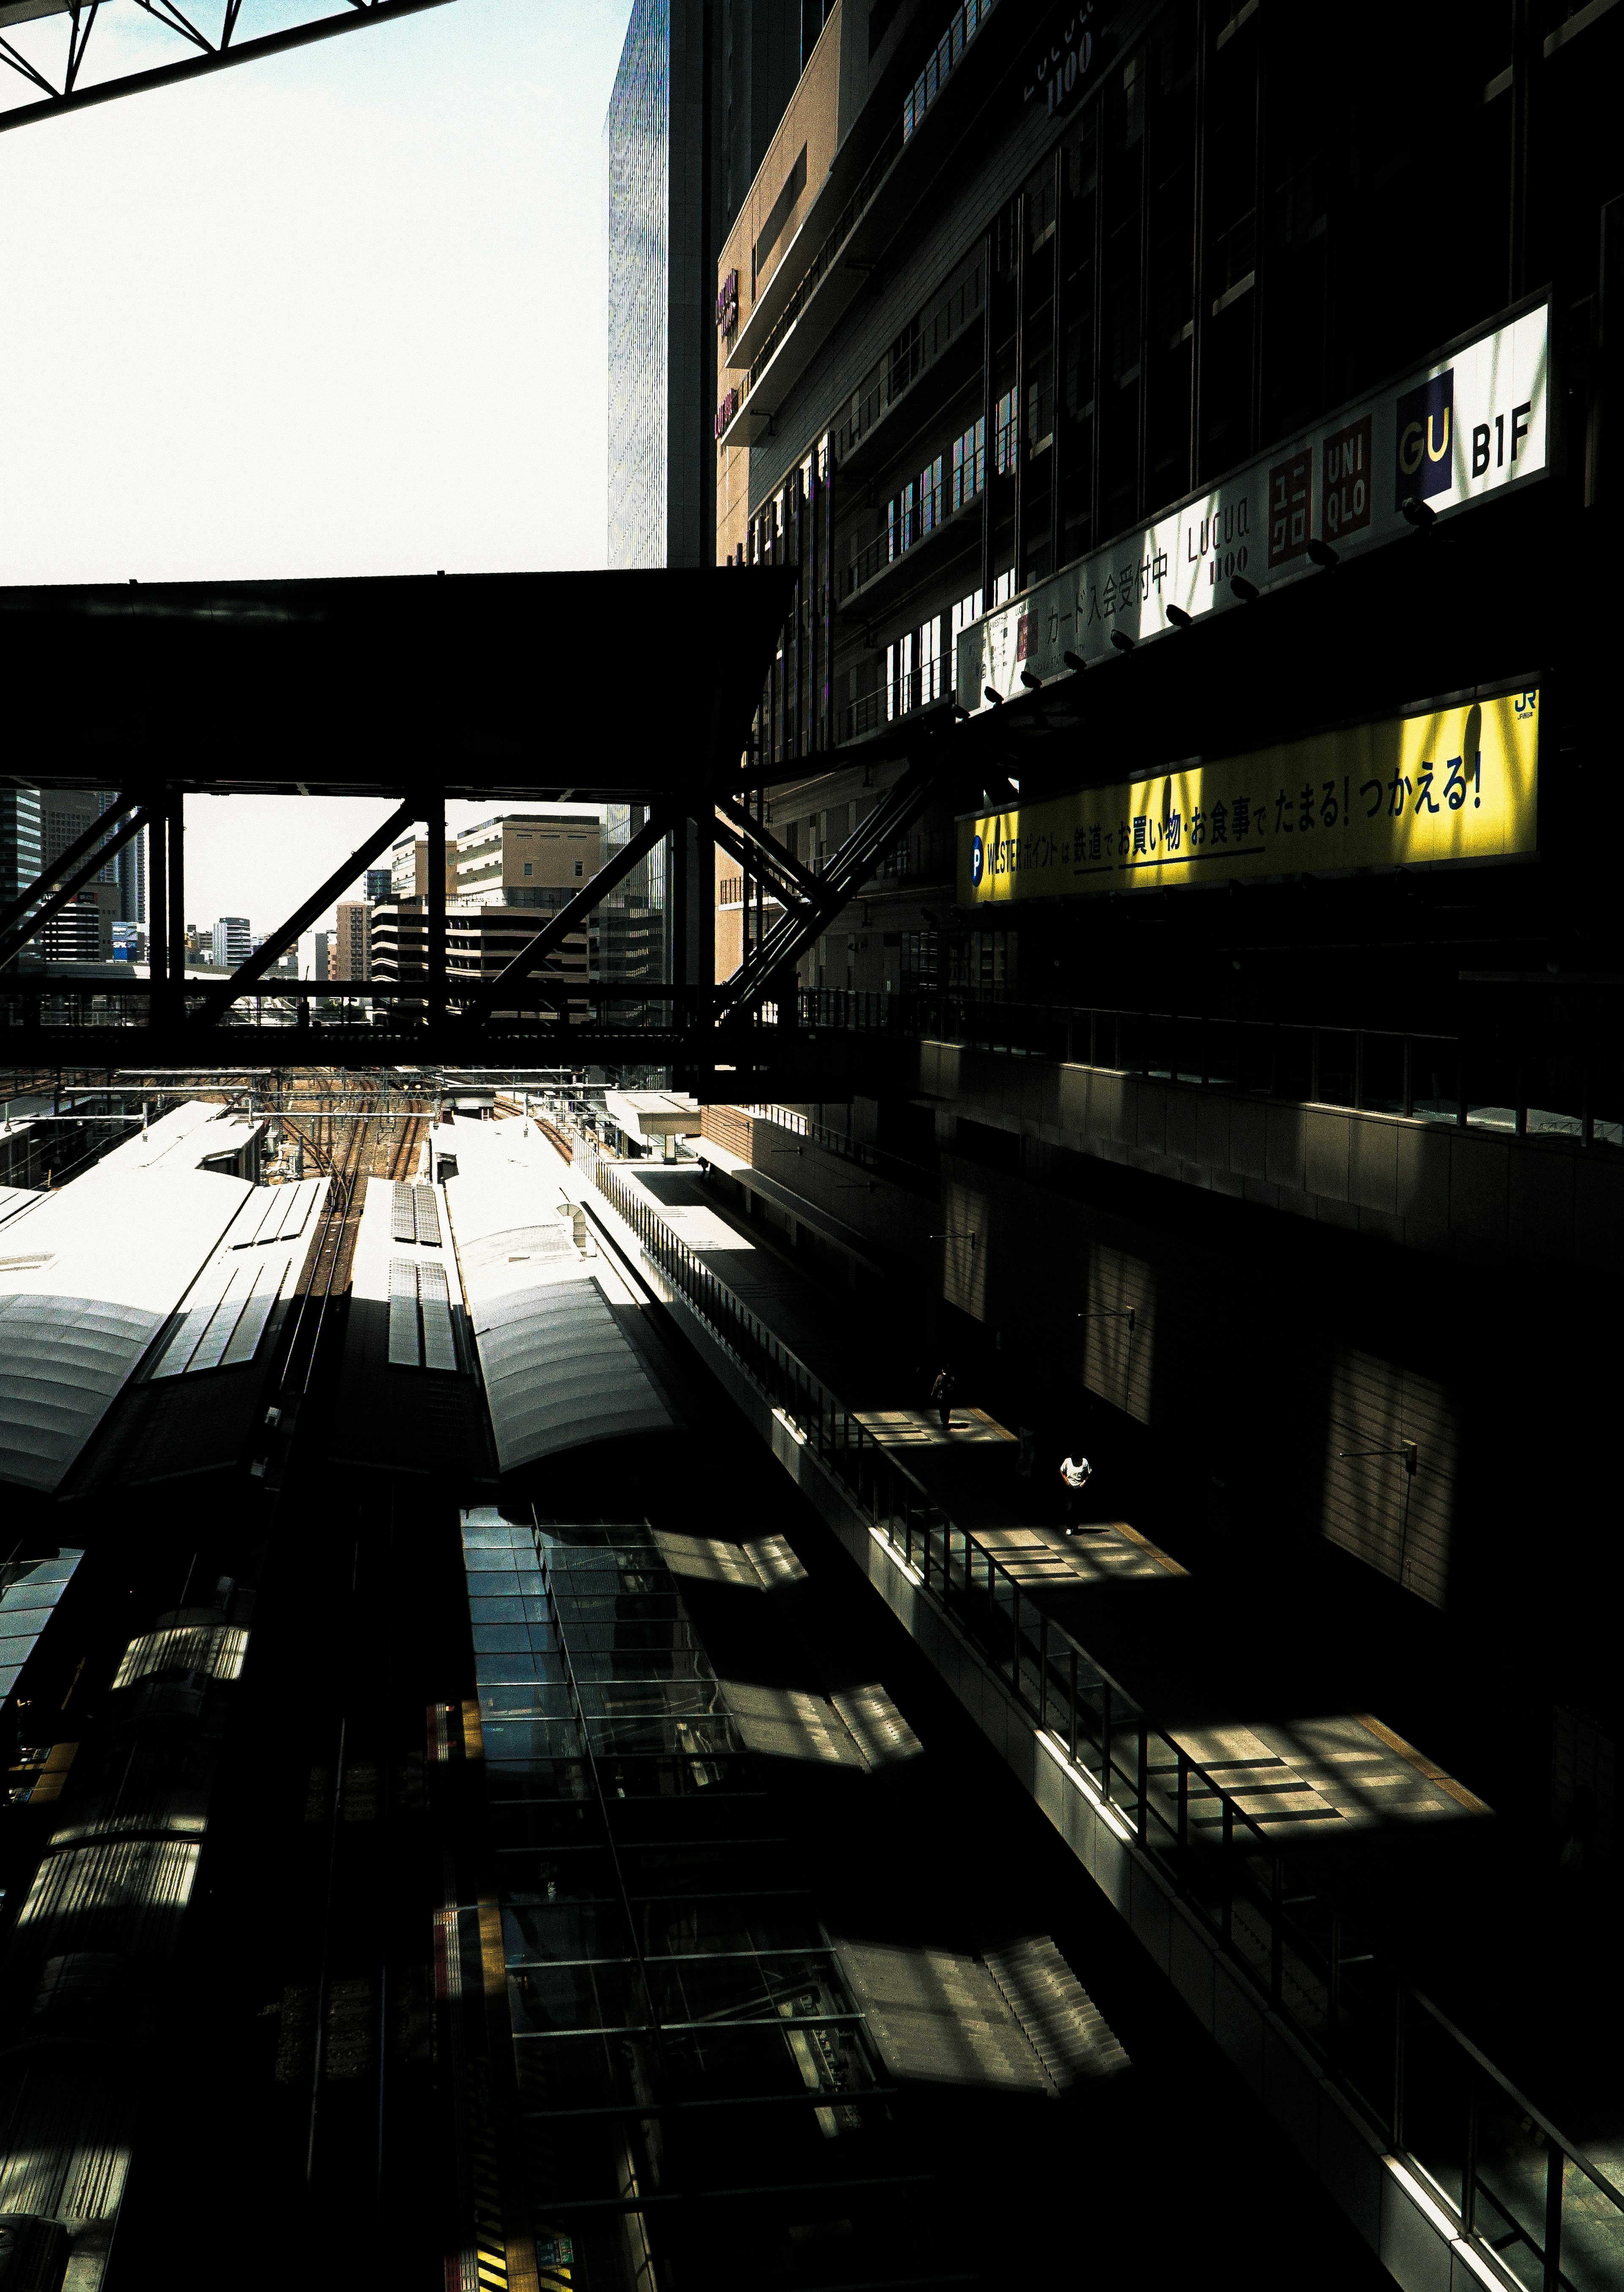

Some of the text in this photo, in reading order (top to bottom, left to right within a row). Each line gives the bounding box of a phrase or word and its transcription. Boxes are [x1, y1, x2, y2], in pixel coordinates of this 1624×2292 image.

[1328, 434, 1363, 482] UNI
[1399, 407, 1450, 475] GU
[1472, 401, 1532, 479] B1F
[1327, 479, 1365, 533] QLO
[1210, 546, 1248, 585] 1100
[1048, 548, 1167, 645] カード入会受付中
[1515, 690, 1536, 712] JR
